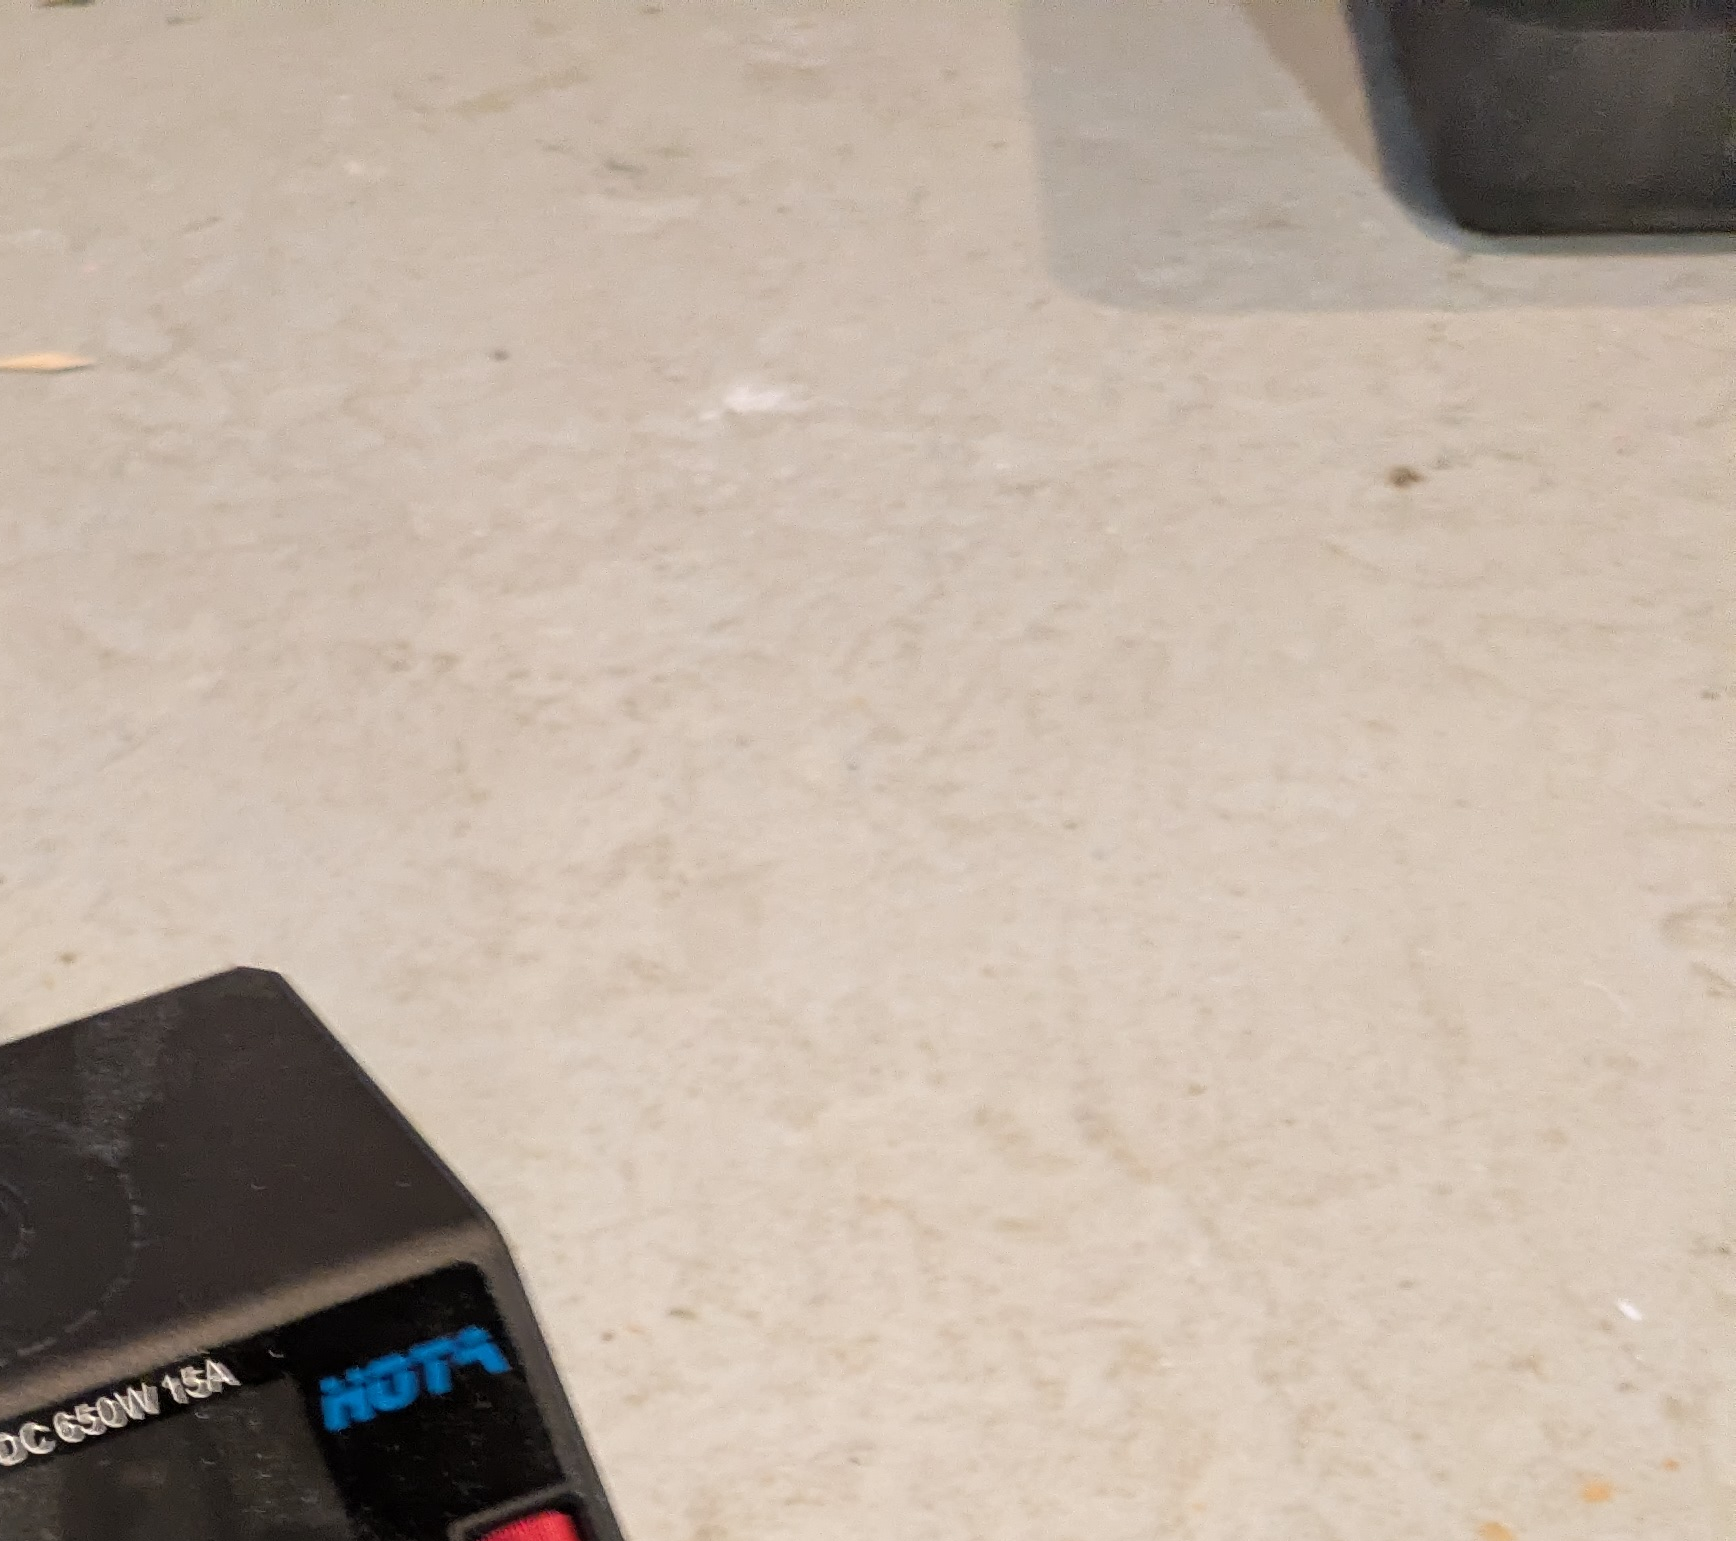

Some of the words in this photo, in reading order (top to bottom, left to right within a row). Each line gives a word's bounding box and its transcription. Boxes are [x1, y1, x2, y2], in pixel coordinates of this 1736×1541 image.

[53, 1382, 160, 1443] 650W
[161, 1359, 242, 1404] 15A
[319, 1324, 513, 1433] HOTA
